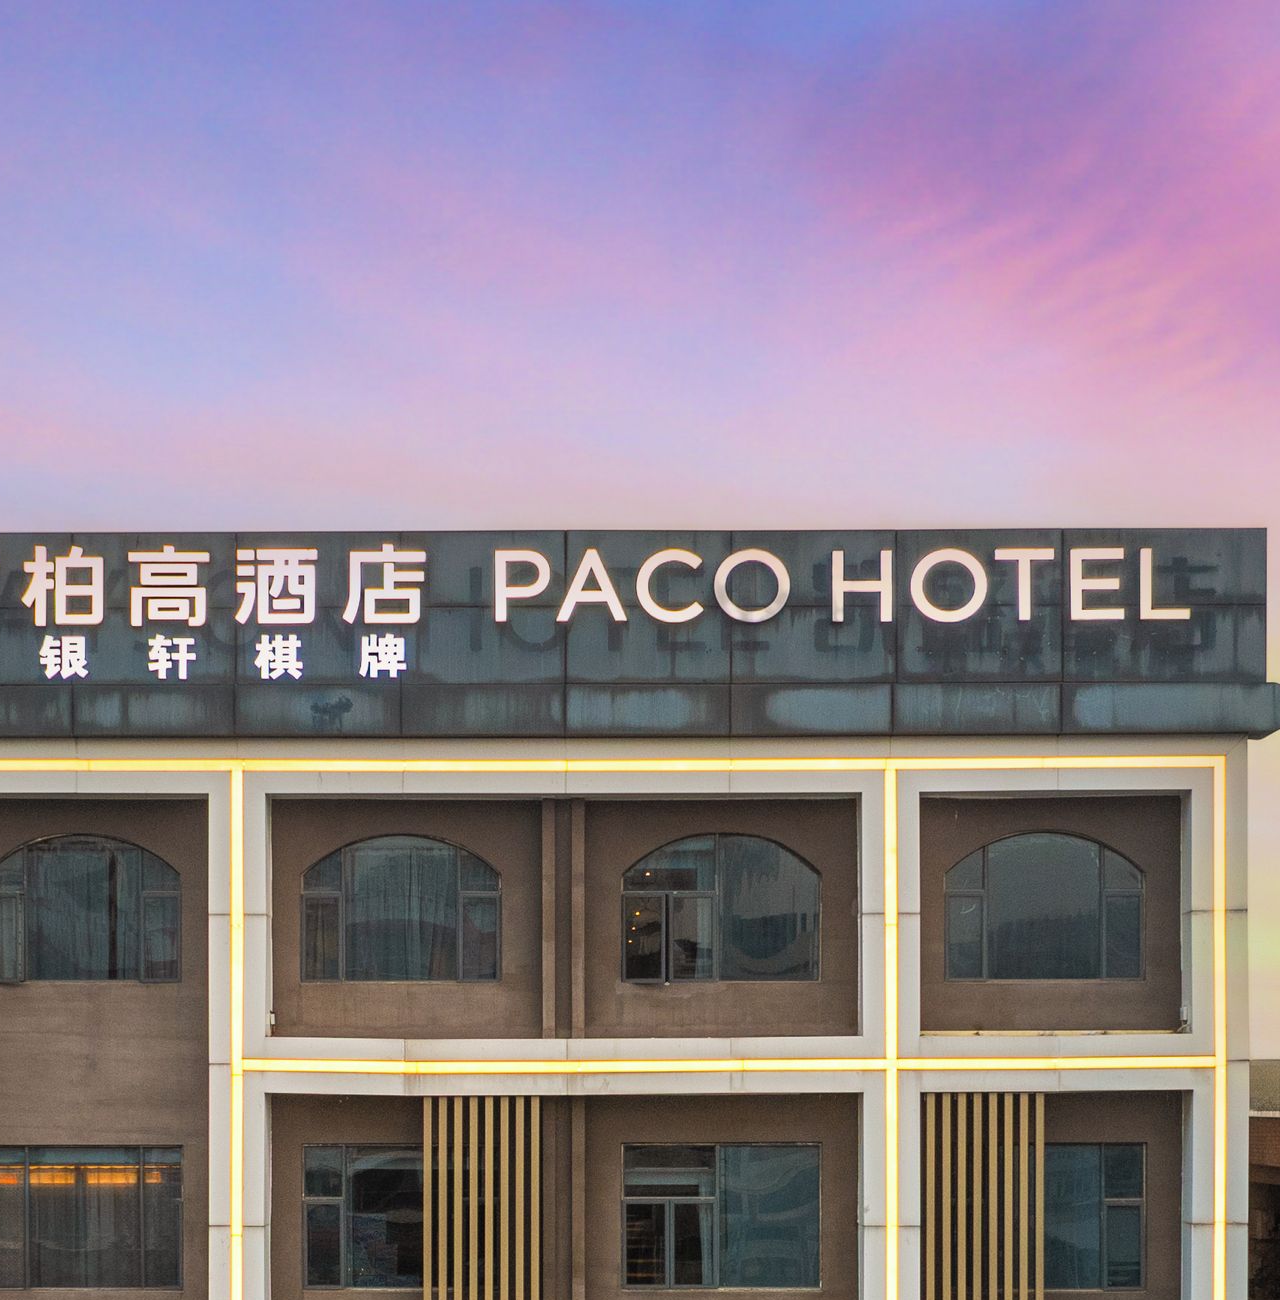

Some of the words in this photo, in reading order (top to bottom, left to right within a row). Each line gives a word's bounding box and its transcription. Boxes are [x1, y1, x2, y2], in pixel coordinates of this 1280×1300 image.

[21, 543, 427, 627] 柏高酒店
[494, 547, 791, 624] PACO
[831, 547, 1192, 624] HOTEL
[38, 634, 407, 680] 银轩棋牌
